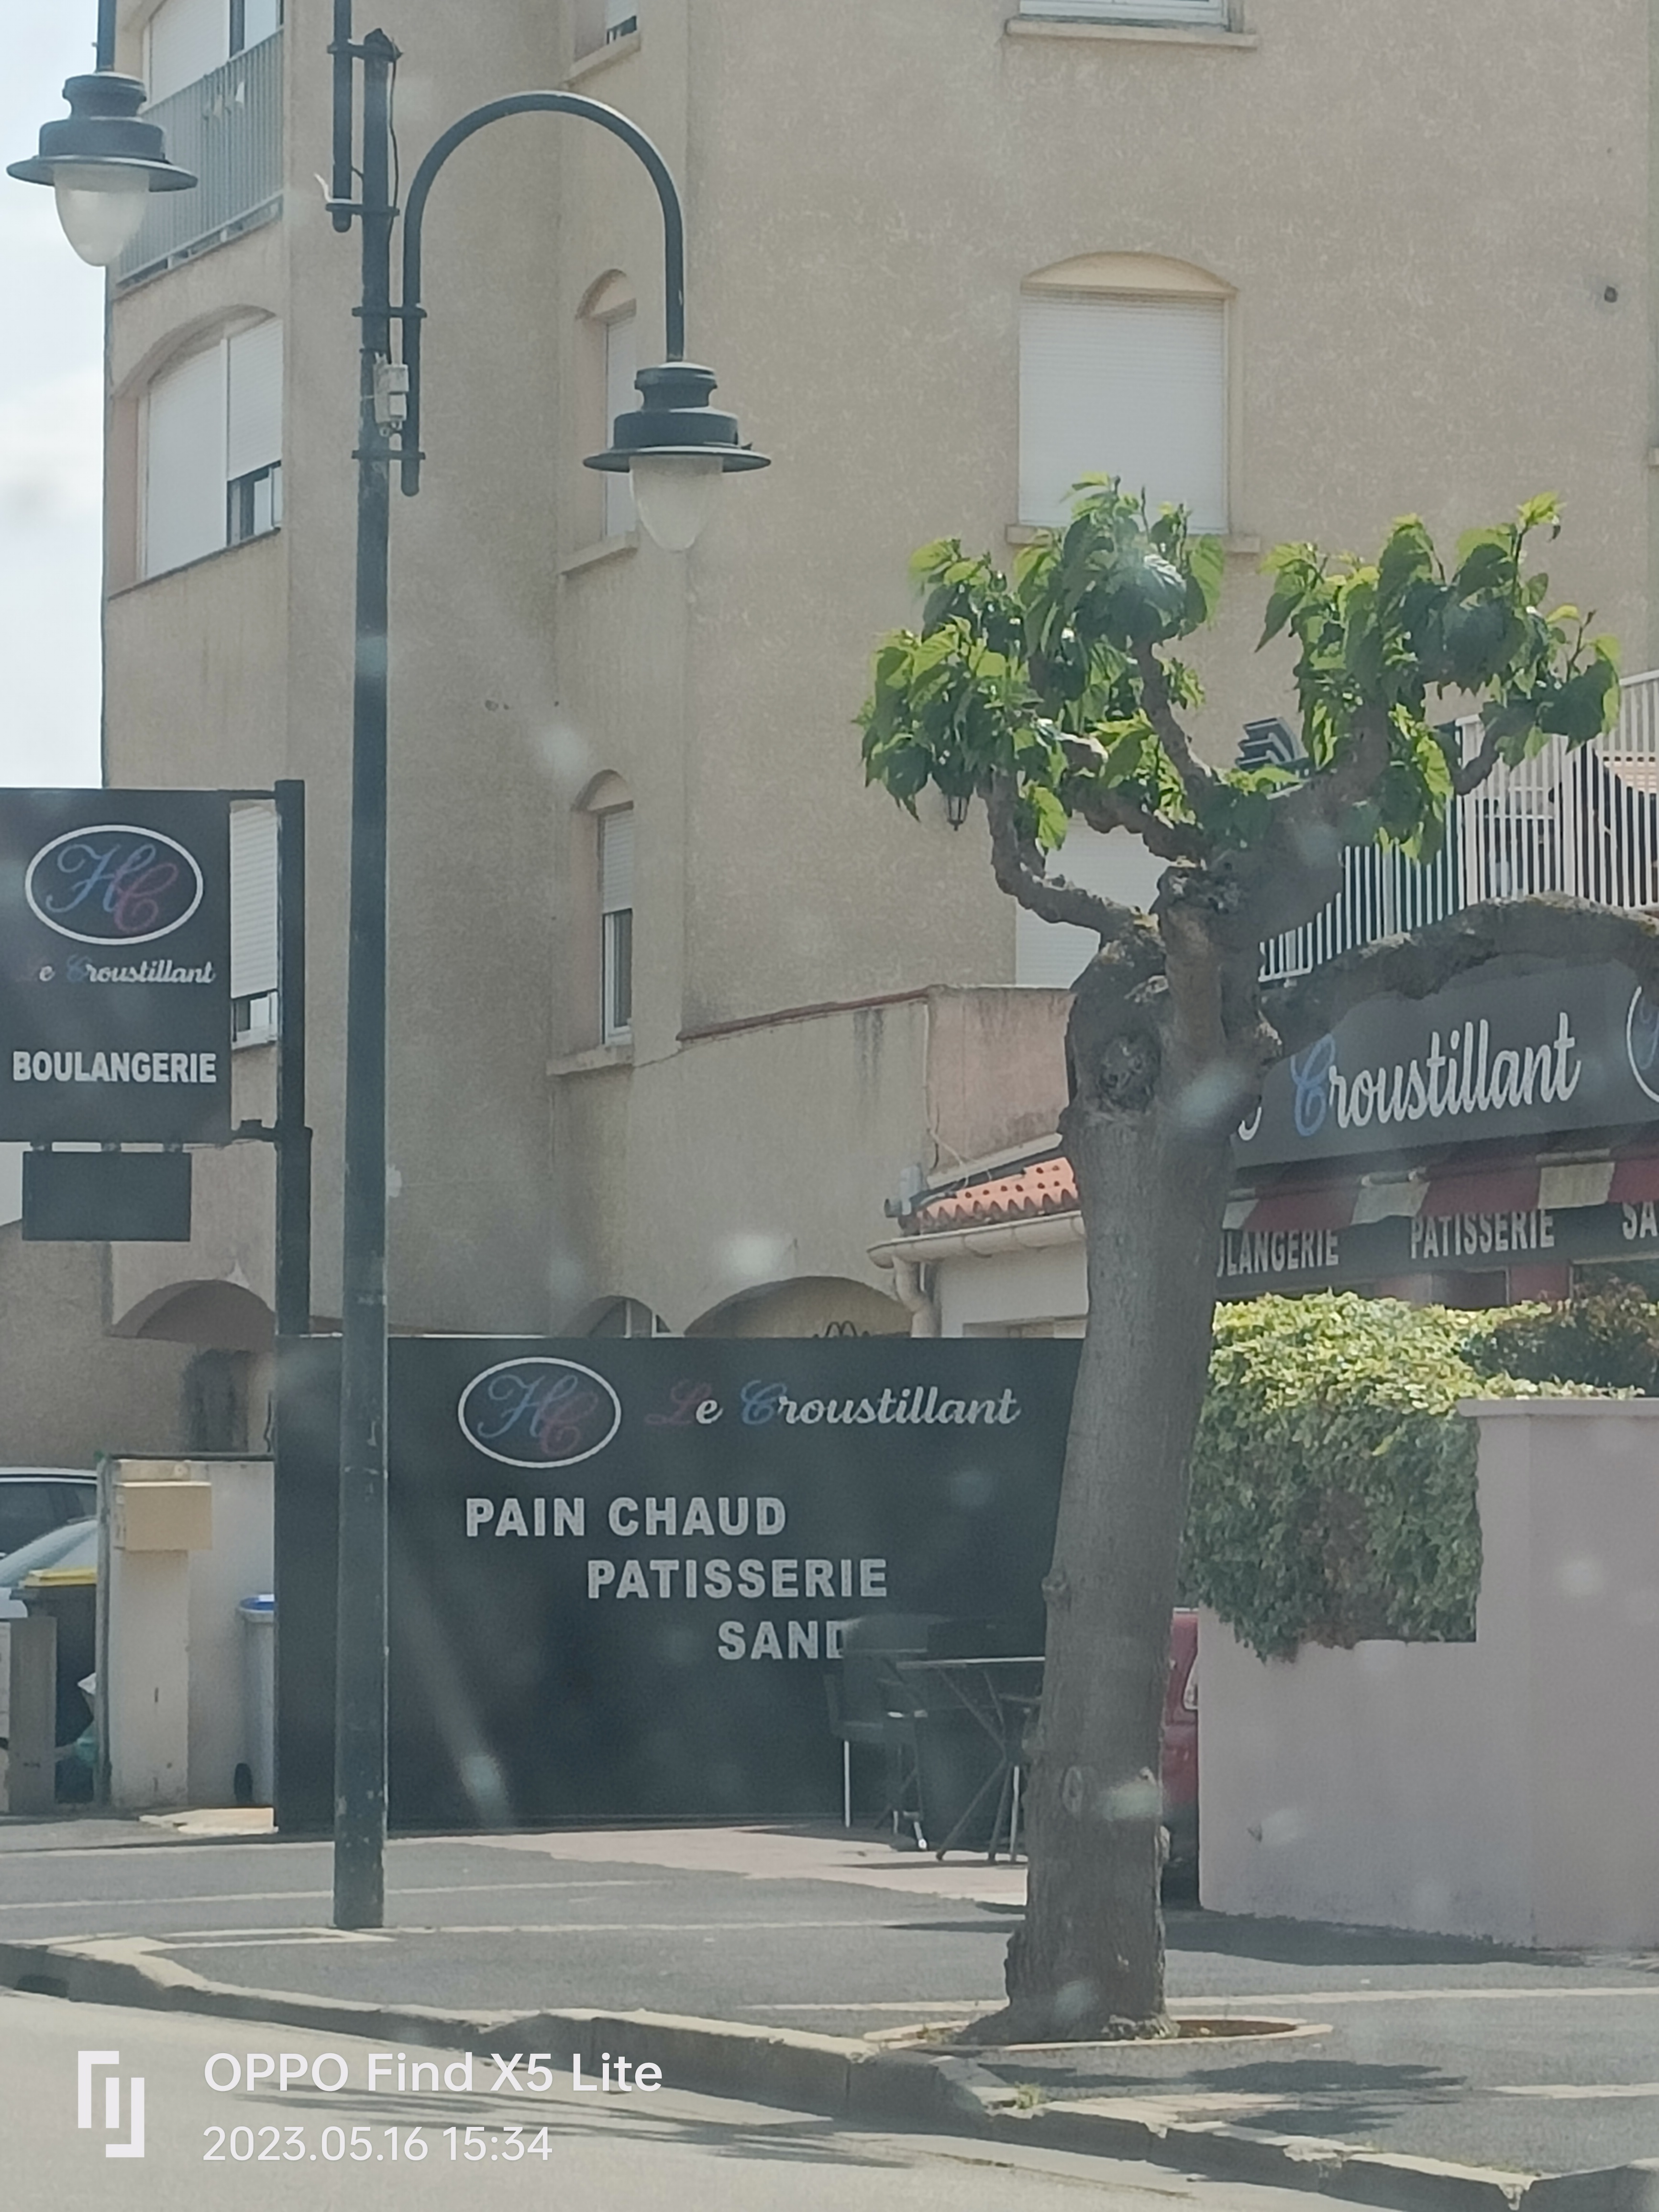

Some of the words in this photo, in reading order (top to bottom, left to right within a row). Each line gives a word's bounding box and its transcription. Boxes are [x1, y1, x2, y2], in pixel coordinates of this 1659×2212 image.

[66, 952, 216, 984] Croustillant
[13, 1051, 216, 1083] BOULANGERIE
[1291, 1010, 1582, 1137] Croustillant
[1410, 1207, 1555, 1259] PATISSERIE
[645, 1382, 723, 1427] Le
[740, 1380, 1021, 1426] Croustillant
[465, 1497, 586, 1537] PAIN
[608, 1496, 786, 1536] CHAUD
[587, 1559, 888, 1599] PATISSERIE
